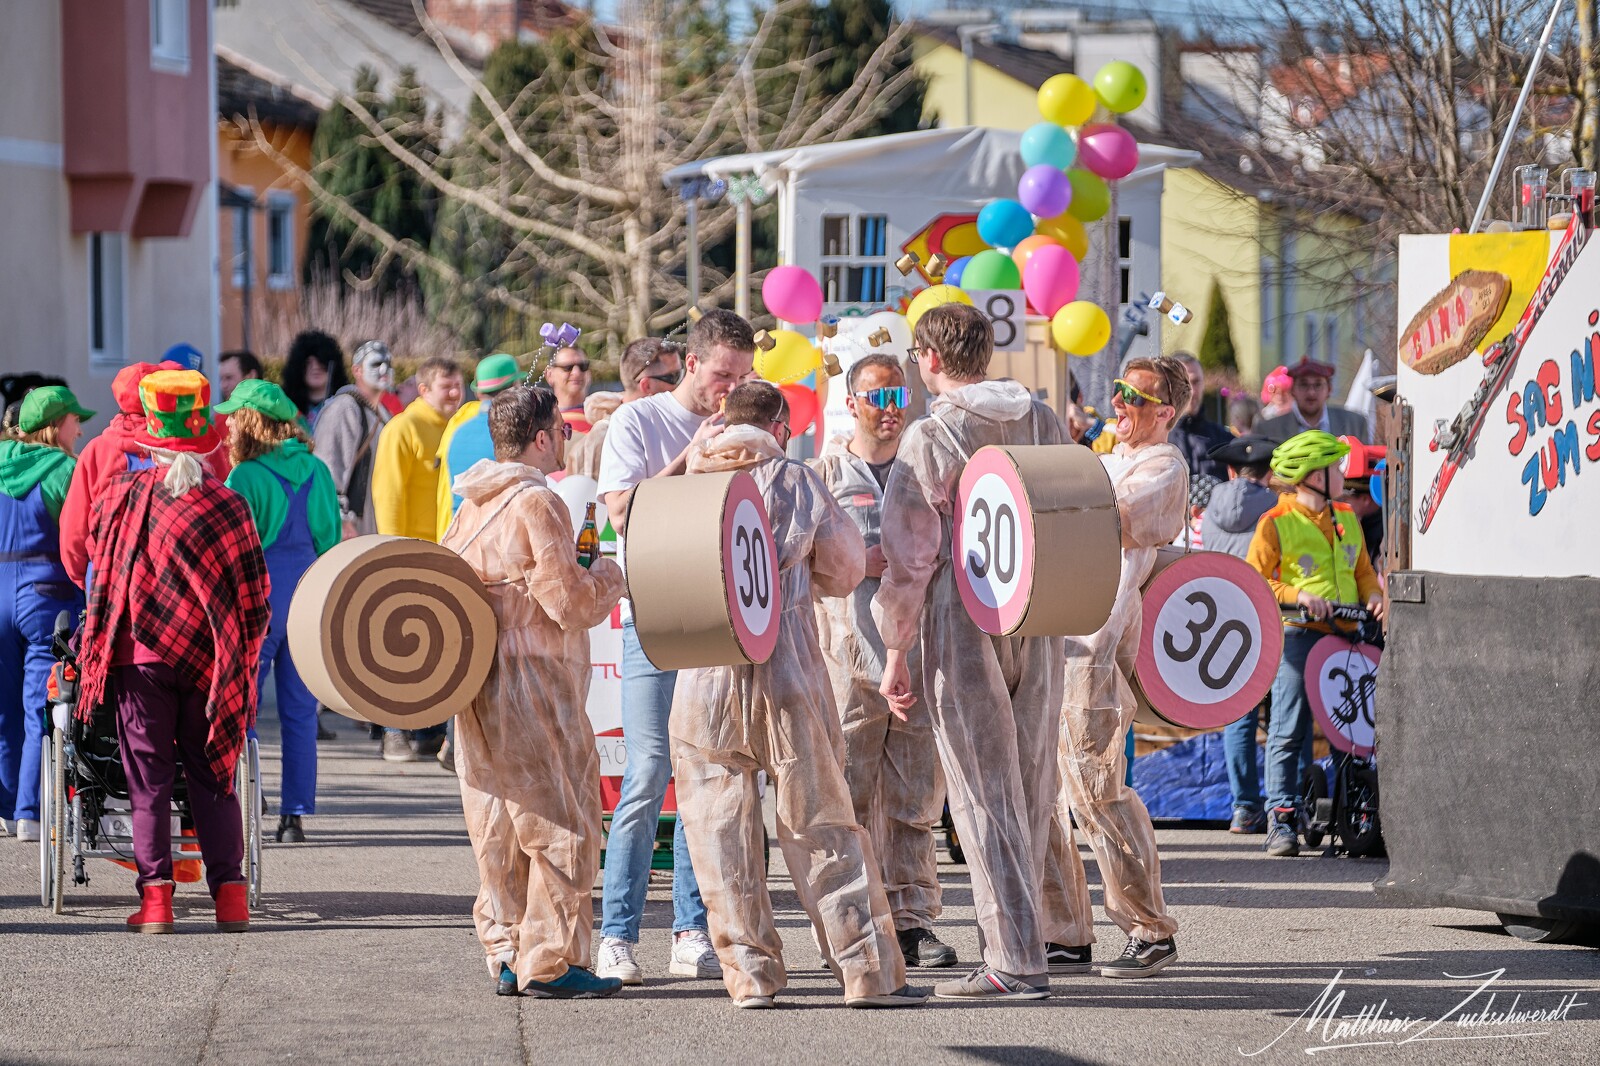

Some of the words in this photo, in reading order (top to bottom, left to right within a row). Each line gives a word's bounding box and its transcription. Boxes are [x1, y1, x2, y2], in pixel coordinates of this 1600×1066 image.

[986, 293, 1016, 347] 8
[1507, 359, 1563, 457] SAG
[1521, 420, 1581, 517] ZUM
[735, 525, 770, 609] 30
[969, 497, 1016, 584] 30
[1163, 591, 1252, 690] 30
